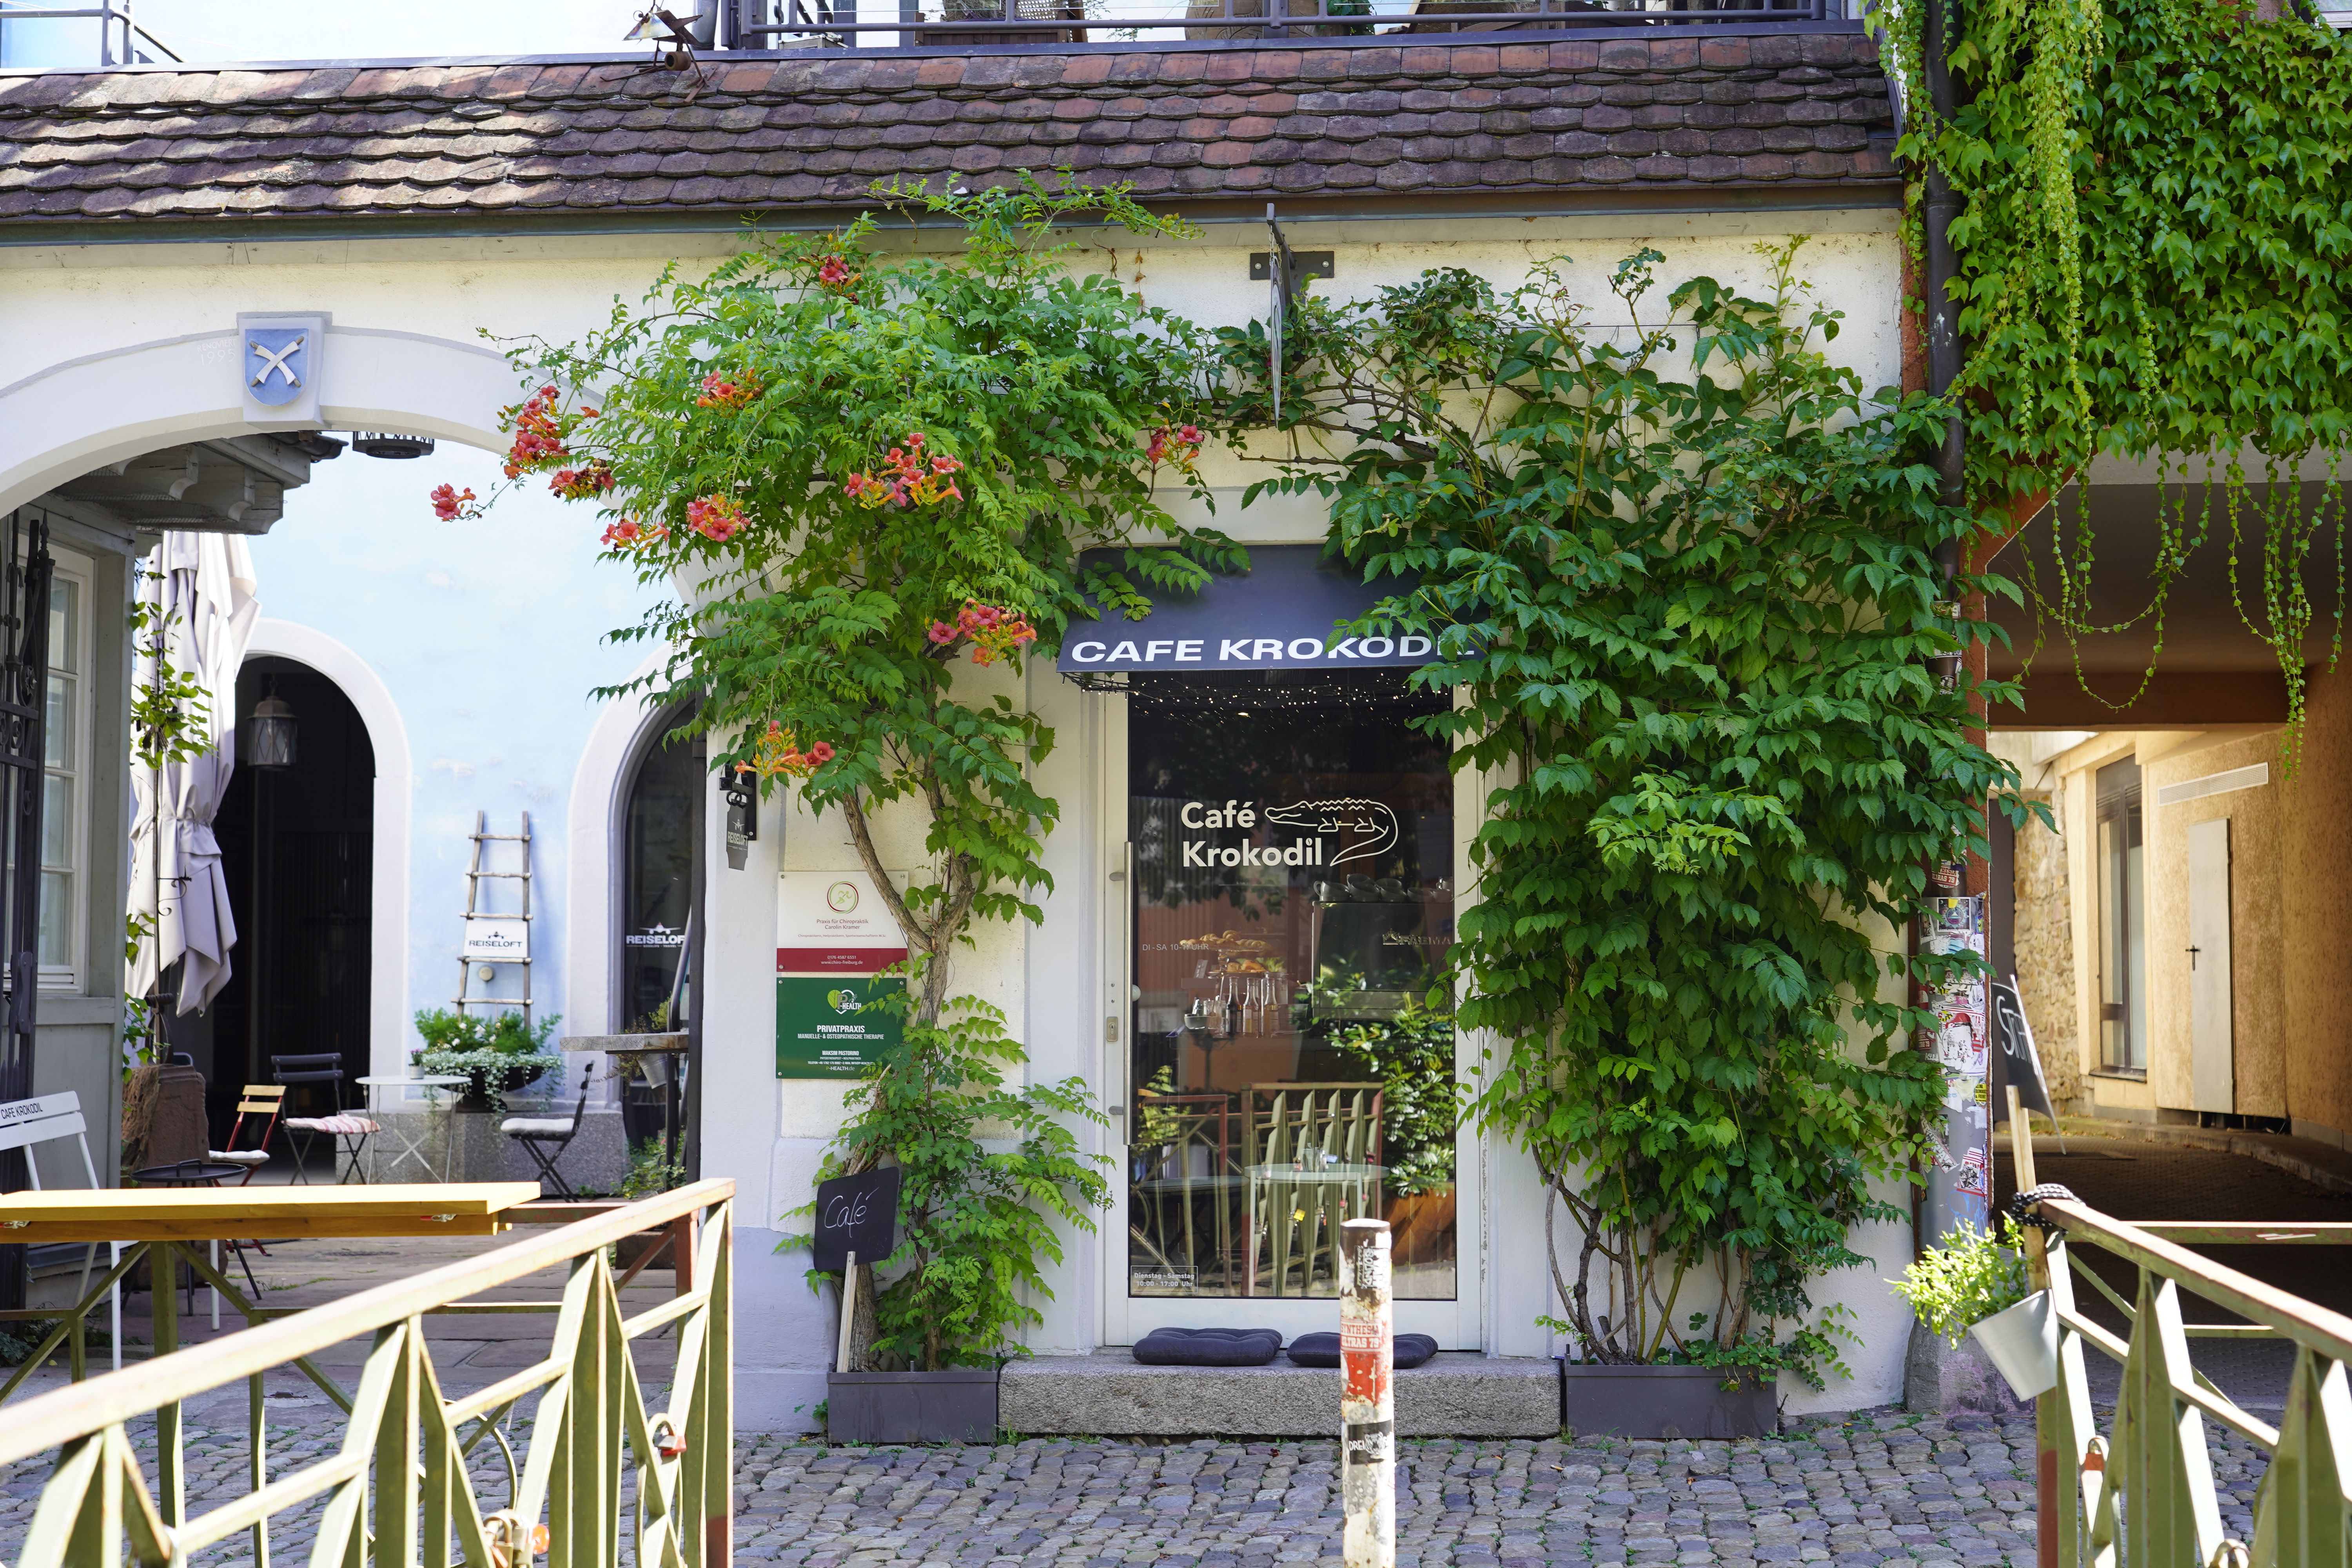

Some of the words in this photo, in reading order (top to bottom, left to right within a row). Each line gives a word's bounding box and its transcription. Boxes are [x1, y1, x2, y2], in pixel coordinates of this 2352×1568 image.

[197, 339, 236, 352] RENOVIERT
[201, 349, 236, 366] 1995
[1072, 639, 1203, 663] CAFE
[1181, 800, 1256, 829] Café
[727, 831, 748, 846] REISELOFT
[1183, 837, 1322, 867] Krokodil
[626, 935, 685, 944] REISELOF
[837, 994, 862, 1010] P-HEALTH
[817, 1025, 865, 1033] PRIVATPRAXIS
[1, 1108, 16, 1119] CAFE
[15, 1102, 44, 1117] KROKODIL
[824, 1187, 880, 1238] Café
[1348, 1439, 1365, 1451] DREI
